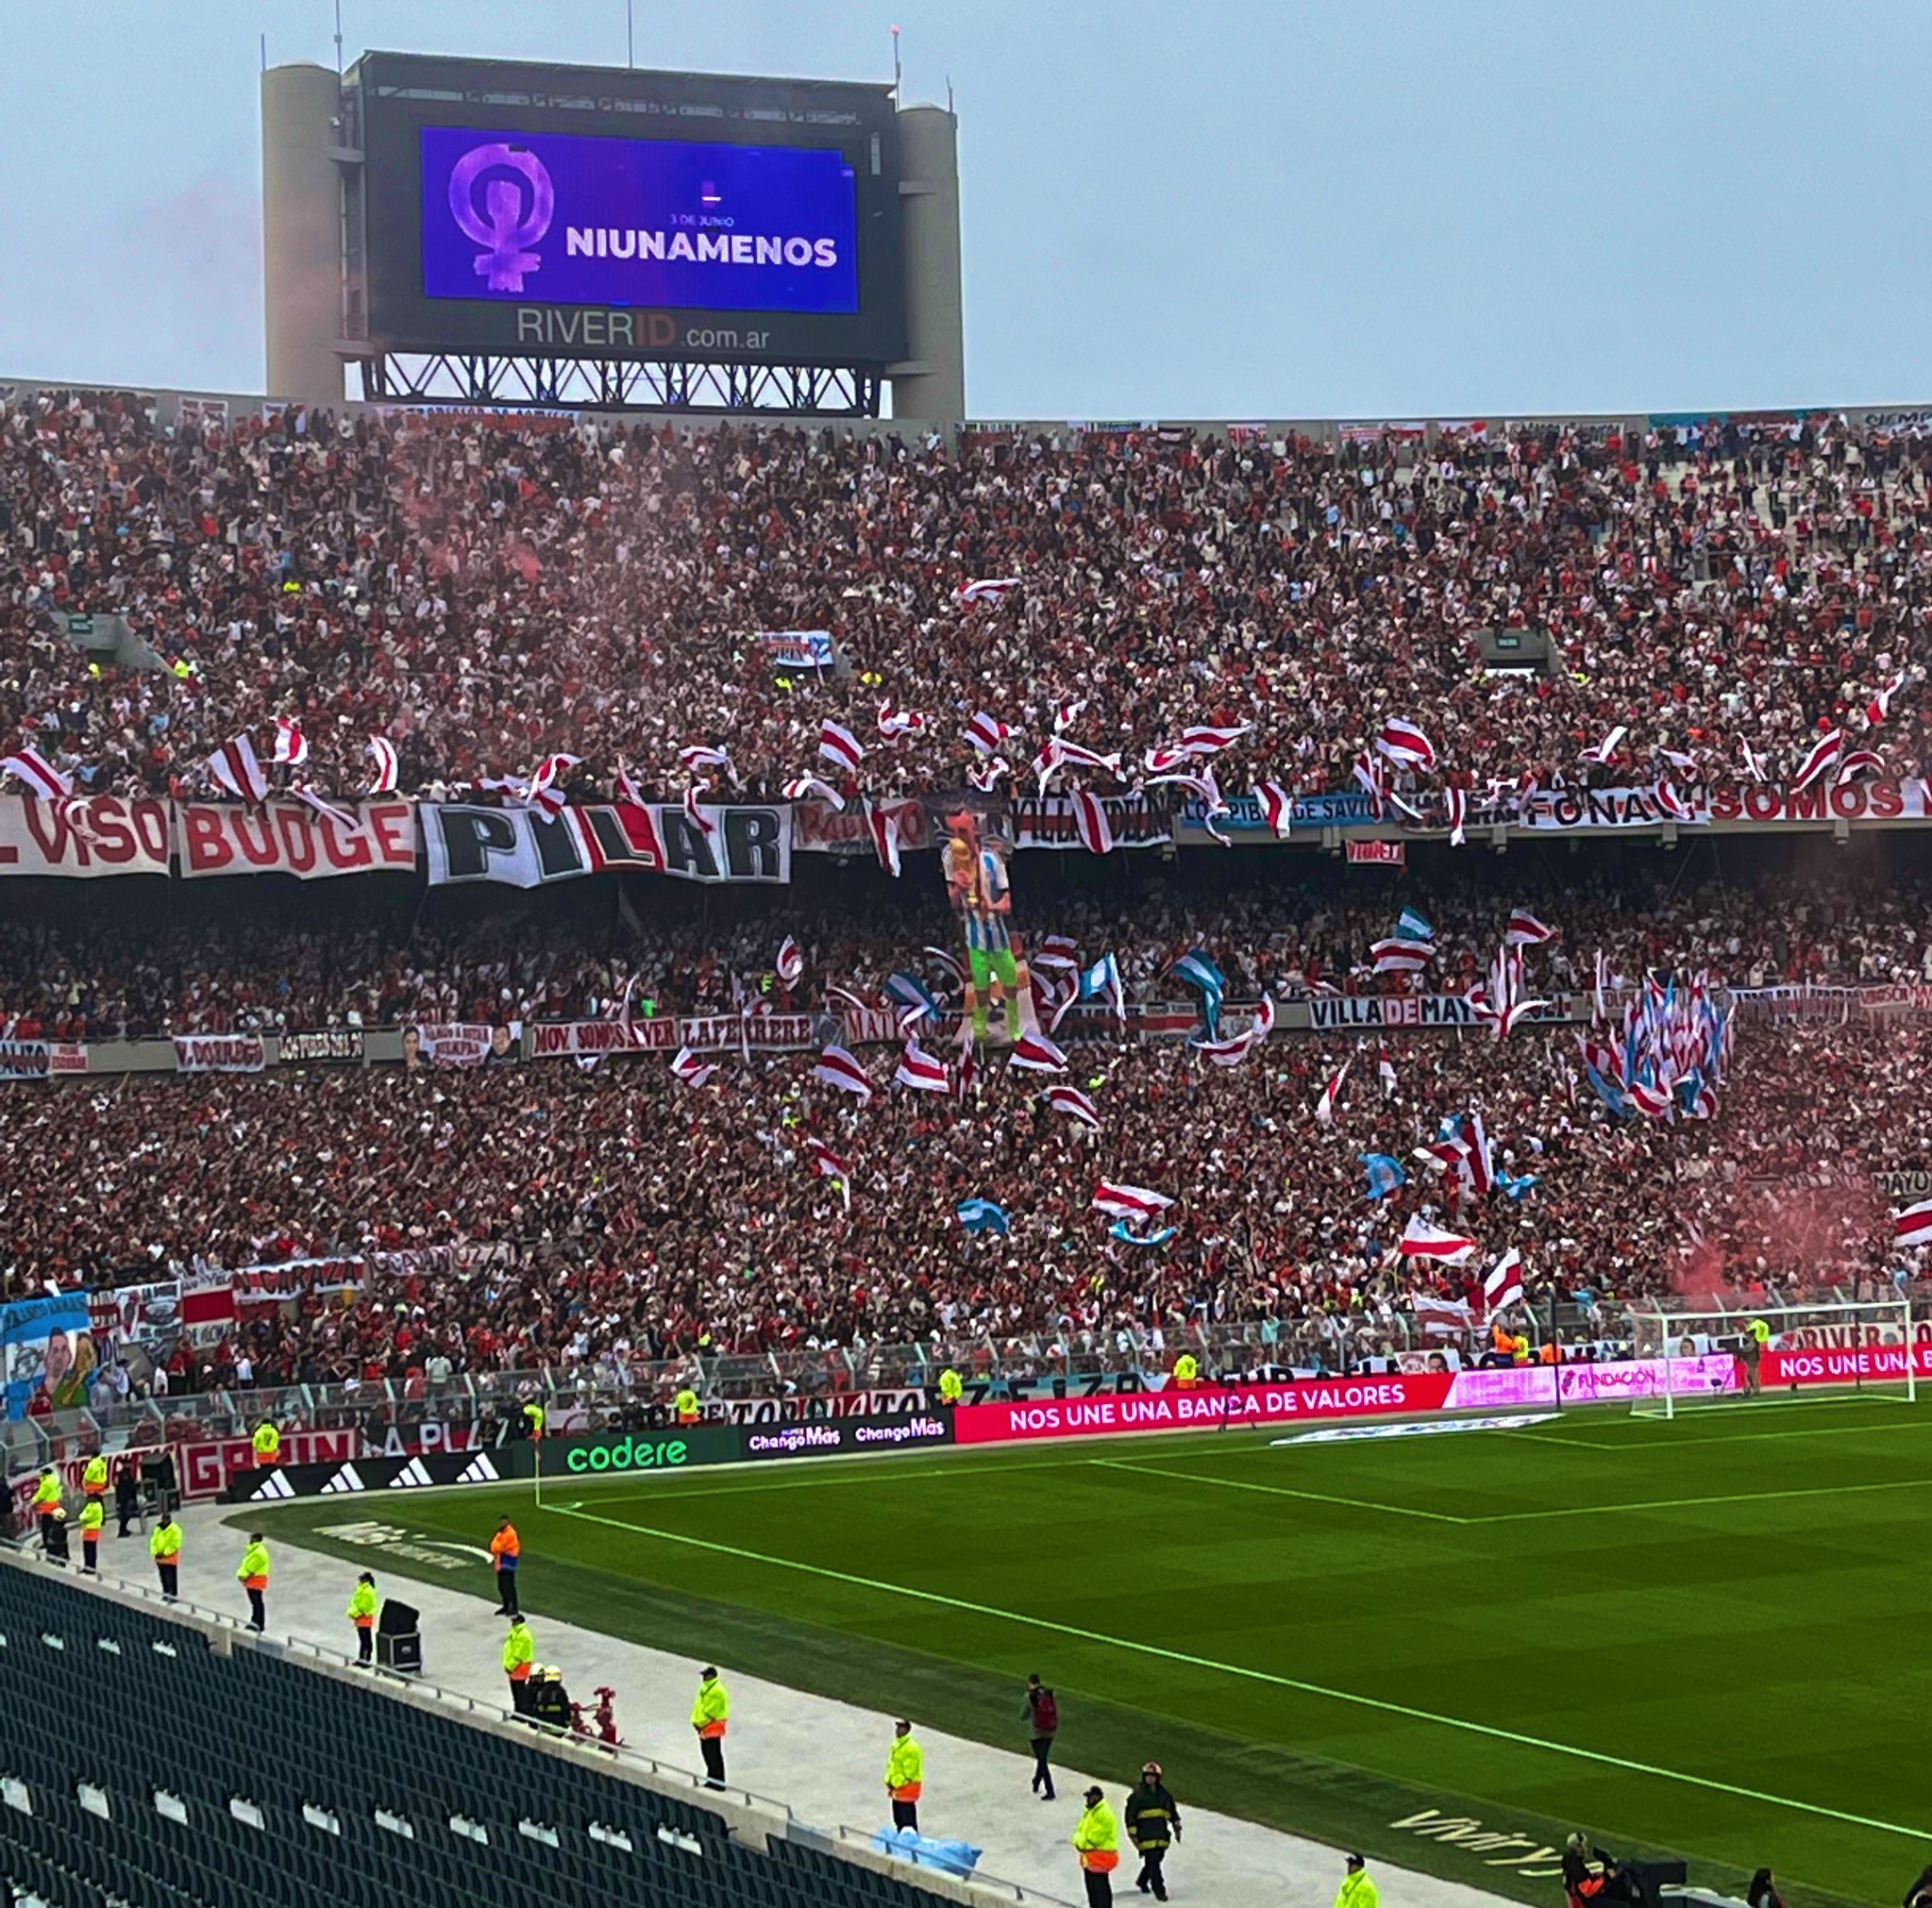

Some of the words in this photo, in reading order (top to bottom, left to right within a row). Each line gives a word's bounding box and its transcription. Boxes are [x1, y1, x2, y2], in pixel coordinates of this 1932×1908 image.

[565, 226, 838, 268] NIUNAMENOS
[517, 307, 677, 347] RIVERID
[1711, 783, 1906, 820] SOMOS
[436, 806, 781, 881] PILAR
[1312, 999, 1383, 1026] VILLA
[1386, 998, 1416, 1024] DE
[1780, 1356, 1824, 1378] NOS
[1828, 1353, 1871, 1375] UNE
[1010, 1408, 1060, 1431] NOS
[1066, 1403, 1116, 1427] UNE
[1120, 1399, 1172, 1423] UNA
[1266, 1391, 1298, 1414] DE
[1302, 1383, 1406, 1409] VALORES
[566, 1435, 688, 1472] codere
